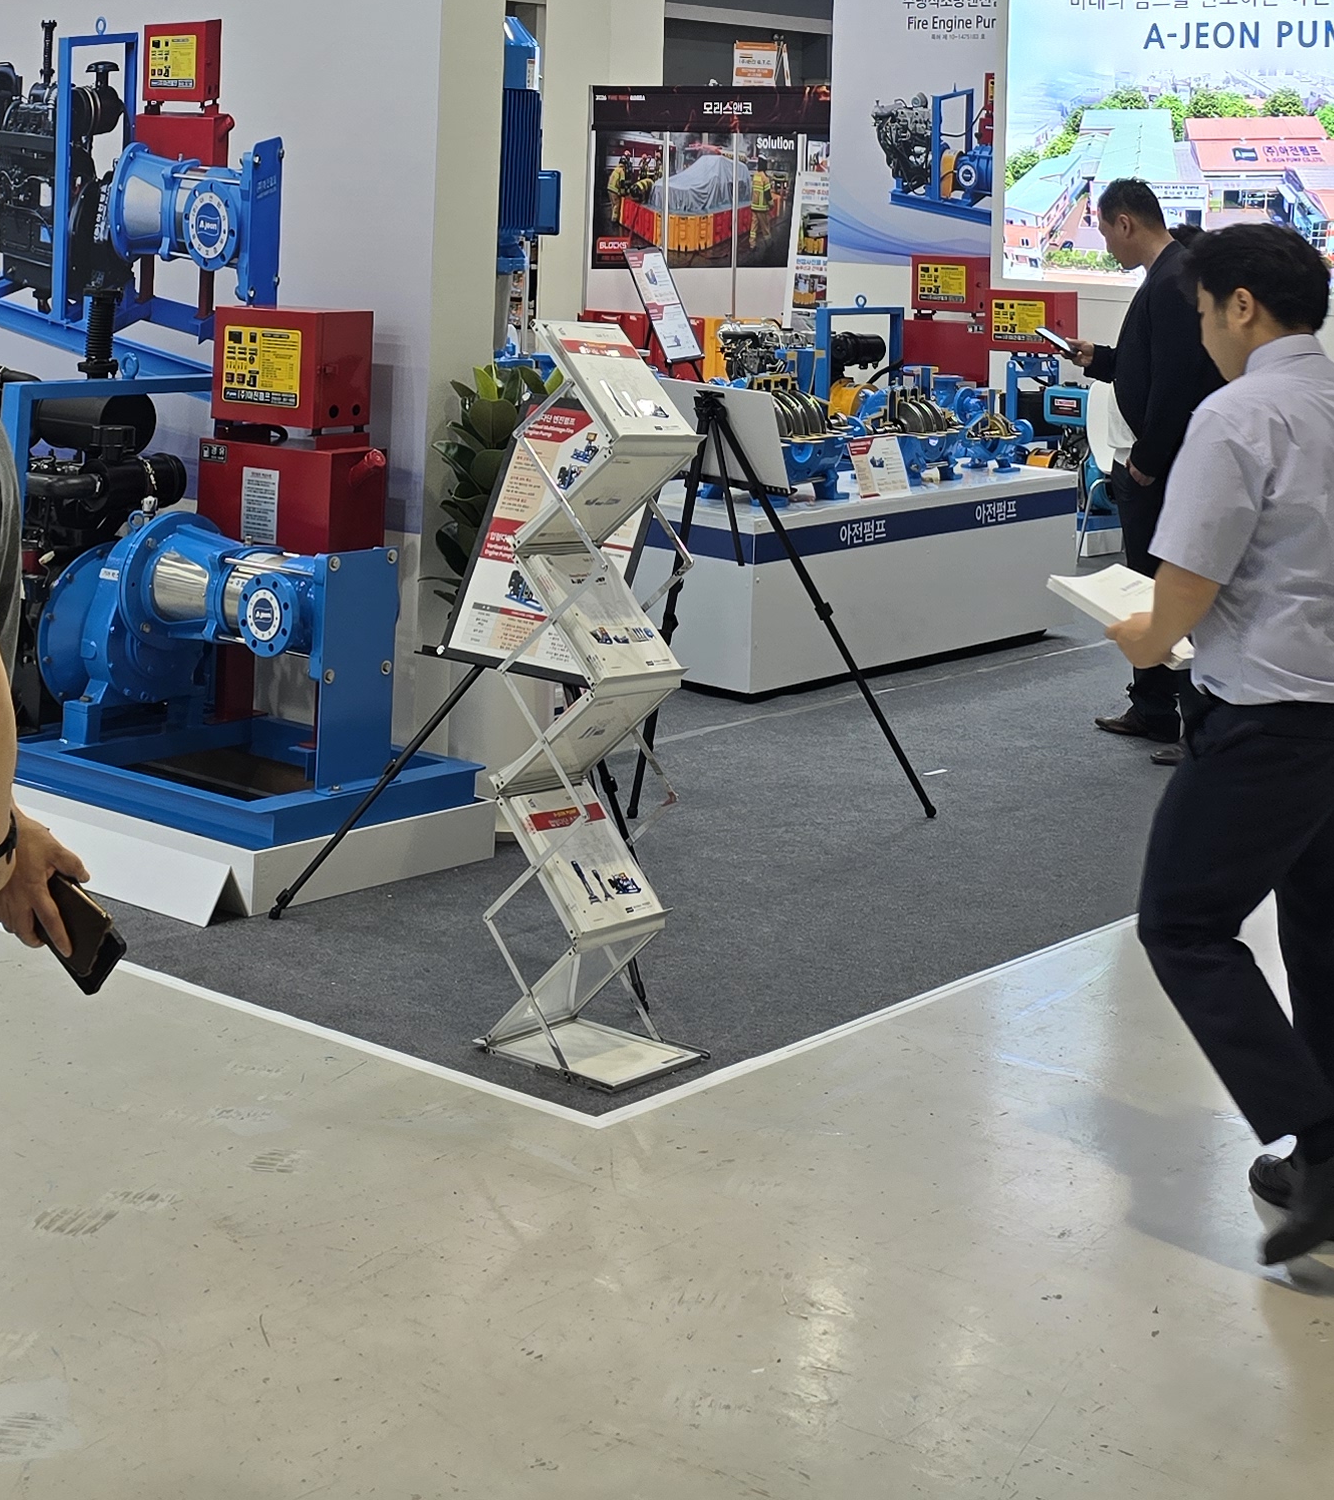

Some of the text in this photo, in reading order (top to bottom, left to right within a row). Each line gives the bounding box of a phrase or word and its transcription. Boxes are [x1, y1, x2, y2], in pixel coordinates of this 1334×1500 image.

[907, 16, 928, 30] Fire
[931, 15, 972, 32] Engine
[1142, 21, 1259, 50] A-JEON
[703, 102, 753, 115] 모리스앤코
[756, 135, 795, 150] solution
[975, 500, 1017, 525] 아전펌프
[839, 519, 887, 546] 아전펌프
